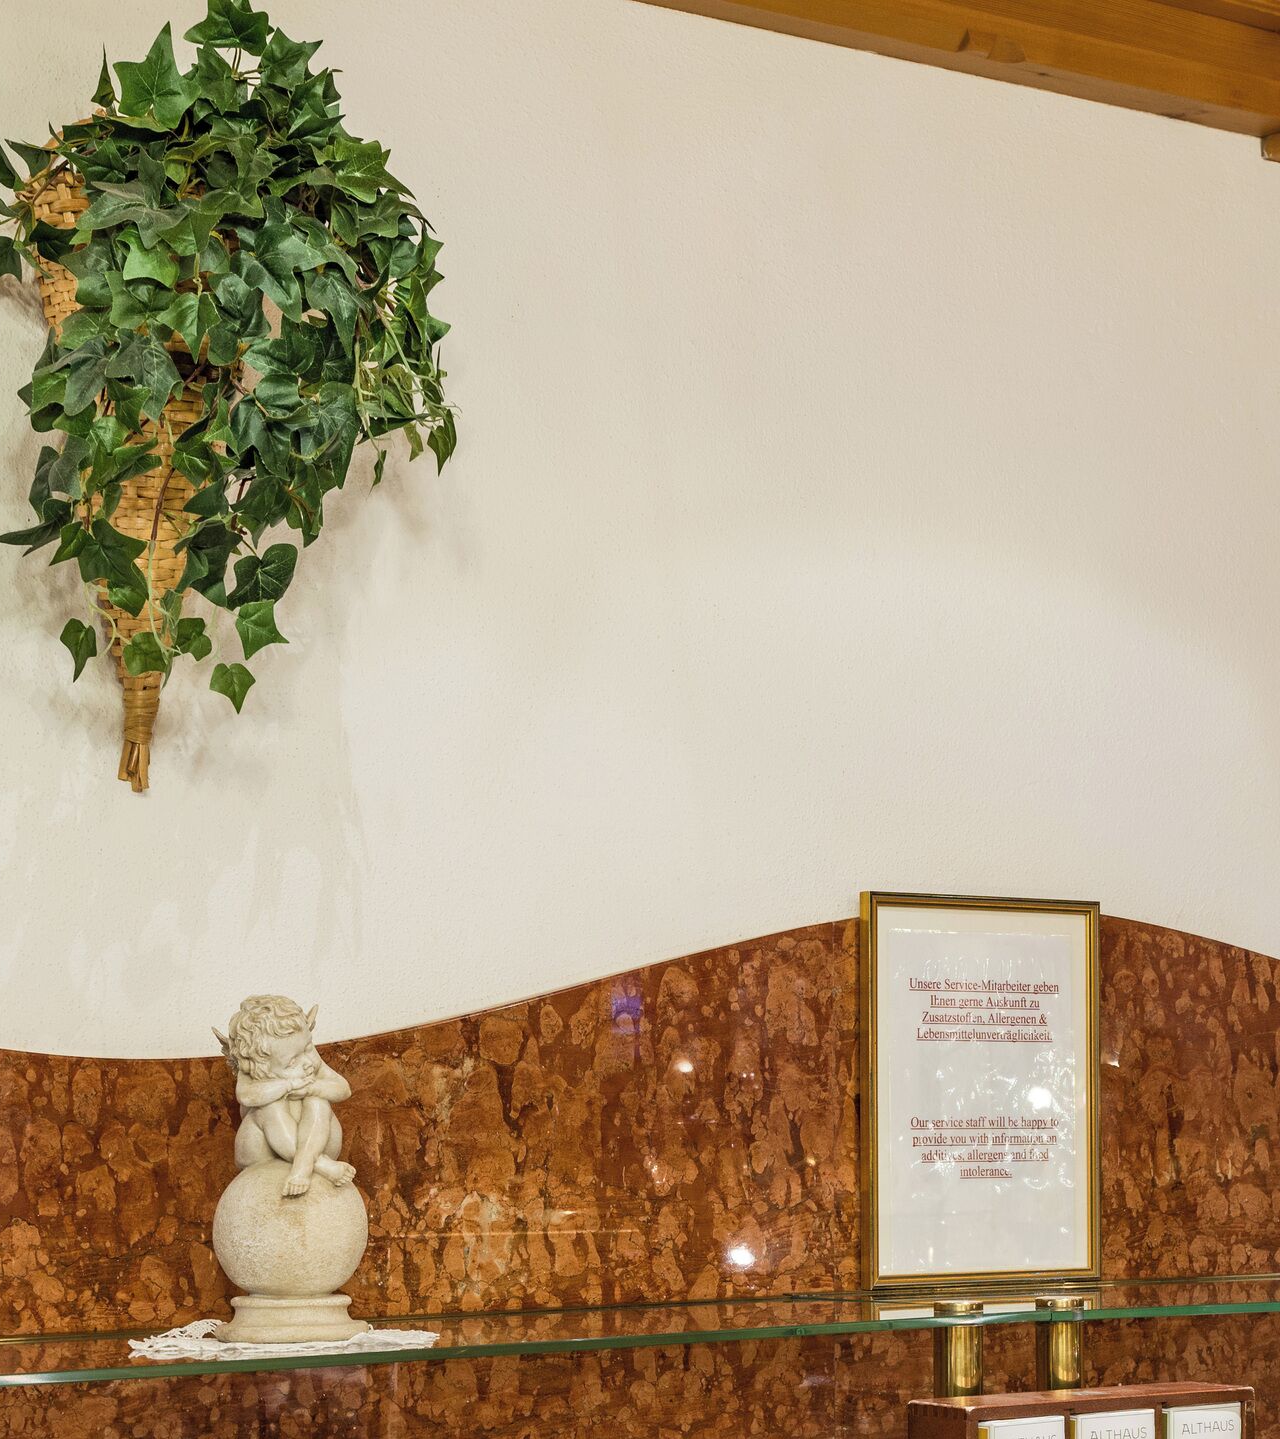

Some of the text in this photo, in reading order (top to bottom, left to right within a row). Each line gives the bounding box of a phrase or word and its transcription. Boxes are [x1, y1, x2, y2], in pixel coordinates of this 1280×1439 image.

[909, 978, 1058, 995] Unsere Service-Mitarbeiter geben
[930, 995, 1040, 1009] Ihnen gerne Auskunft zu
[988, 1013, 1036, 1026] Allergenen
[1039, 1014, 1047, 1024] &
[910, 1116, 1059, 1129] Our service staff will be happy to
[912, 1133, 947, 1146] provide
[950, 1136, 966, 1146] you
[969, 1133, 988, 1144] with
[1046, 1135, 1057, 1144] on
[960, 1166, 1012, 1177] intolerance.
[1181, 1419, 1235, 1435] ALTHAUS
